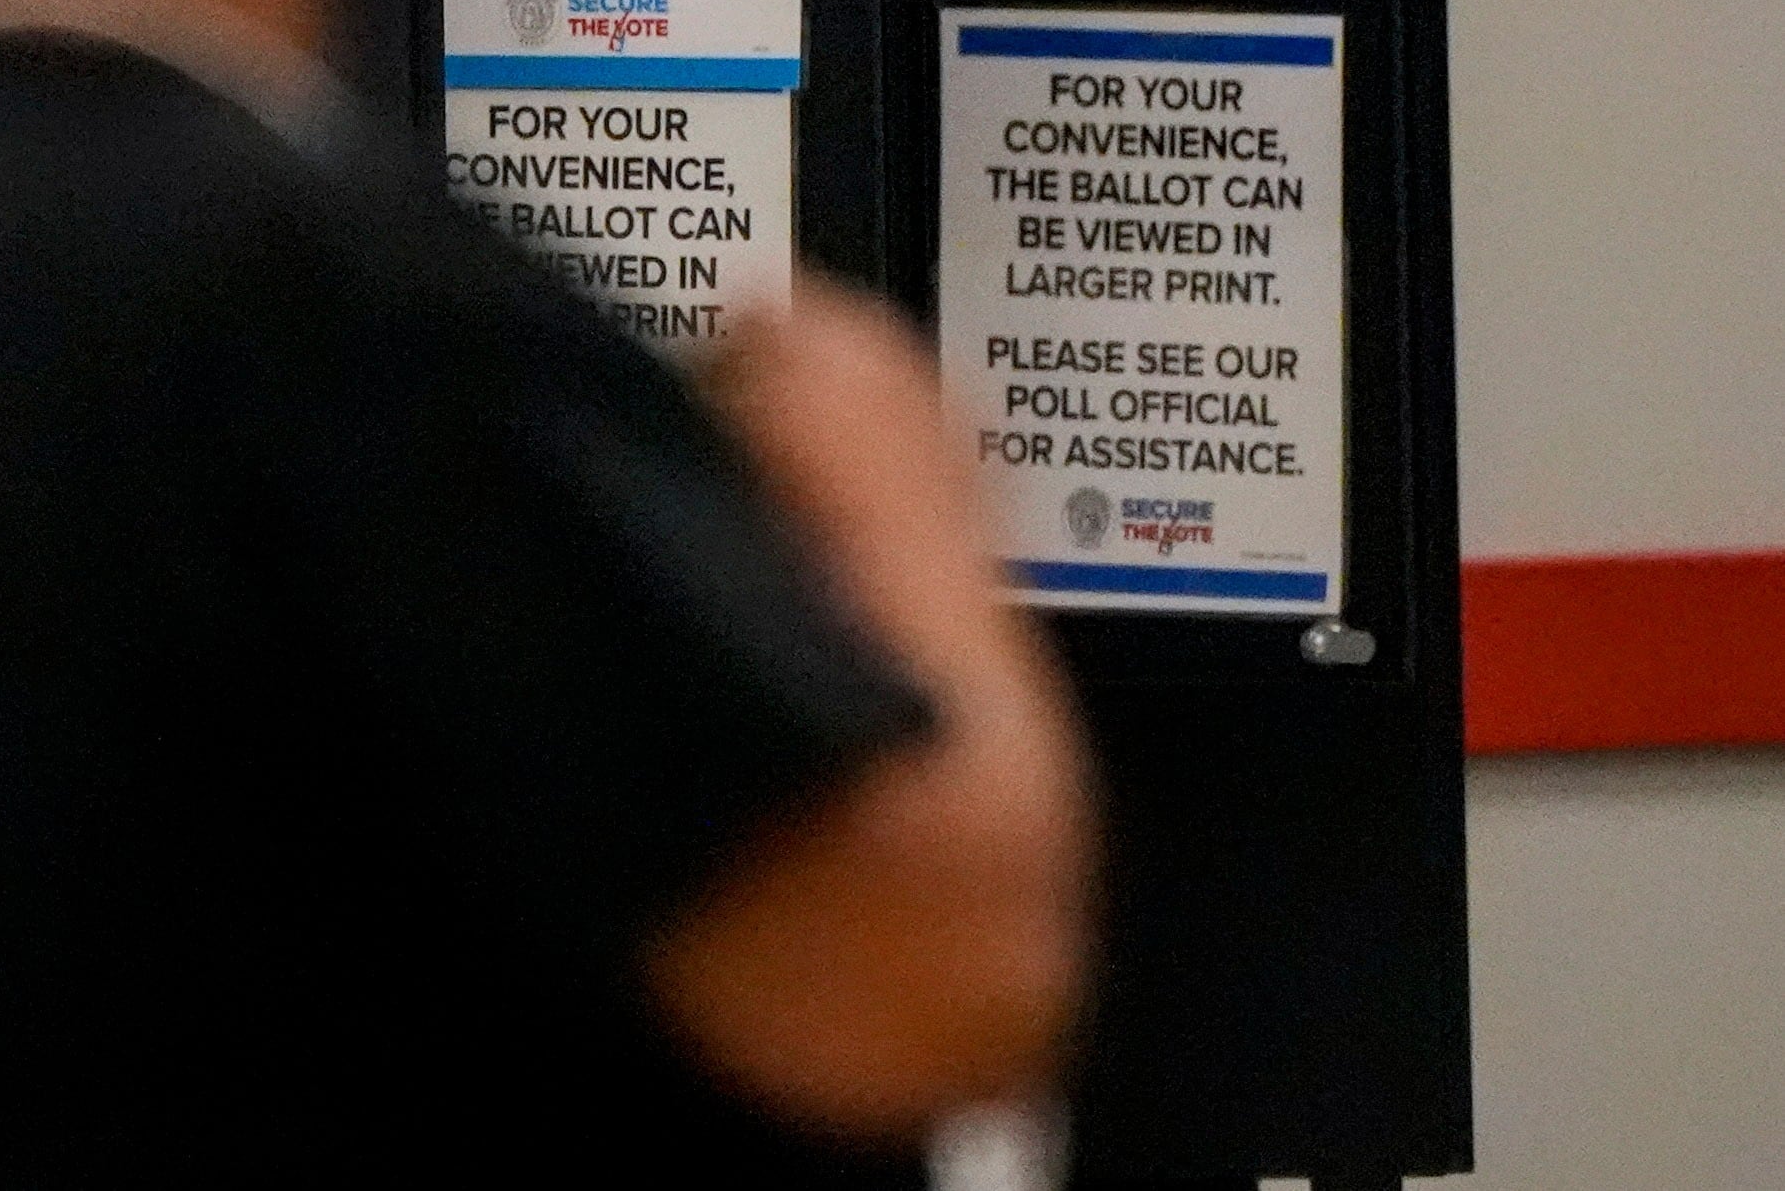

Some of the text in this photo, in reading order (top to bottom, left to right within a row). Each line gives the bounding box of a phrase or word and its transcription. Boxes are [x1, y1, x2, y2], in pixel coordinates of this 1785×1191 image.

[1049, 73, 1243, 112] FOR YOUR
[489, 104, 689, 143] FOR YOUR
[1003, 120, 1288, 167] CONVENIENCE,
[446, 153, 736, 198] CONVENIENCE,
[984, 166, 1304, 212] THE BALLOT CAN
[511, 201, 658, 240] BALLOT
[668, 206, 752, 242] CAN
[1017, 215, 1271, 259] BE VIEWED IN
[679, 256, 718, 290] IN
[1005, 264, 1282, 307] LARGER PRINT.
[987, 336, 1299, 381] PLEASE SEE OUR
[1006, 384, 1280, 428] POLL OFFICIAL
[978, 430, 1305, 478] FOR ASSISTANCE.
[1120, 496, 1214, 522] SECURE
